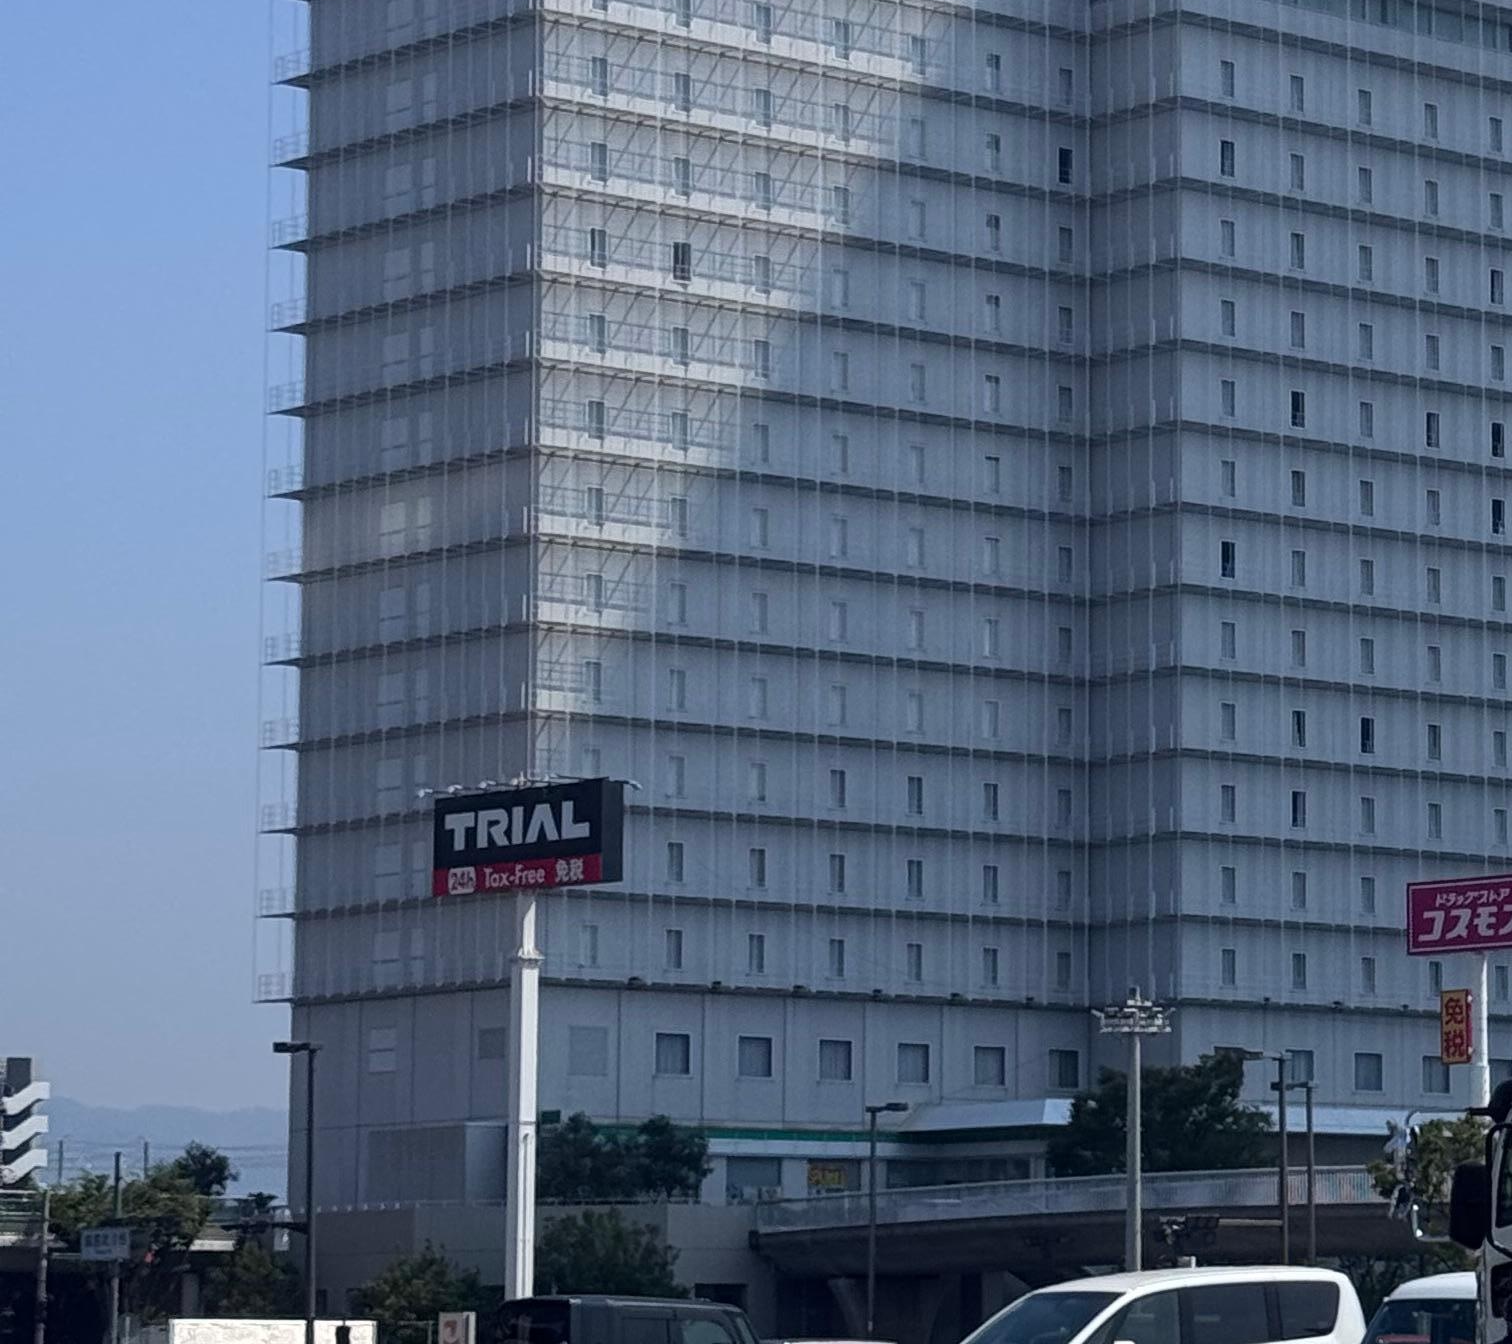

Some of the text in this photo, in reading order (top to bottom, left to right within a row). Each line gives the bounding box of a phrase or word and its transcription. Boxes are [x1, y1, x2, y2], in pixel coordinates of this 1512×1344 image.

[444, 800, 591, 852] TRIAL
[483, 864, 546, 889] Tax-Free
[1435, 888, 1511, 908] ドラッグストア
[1443, 997, 1465, 1058] 免税
